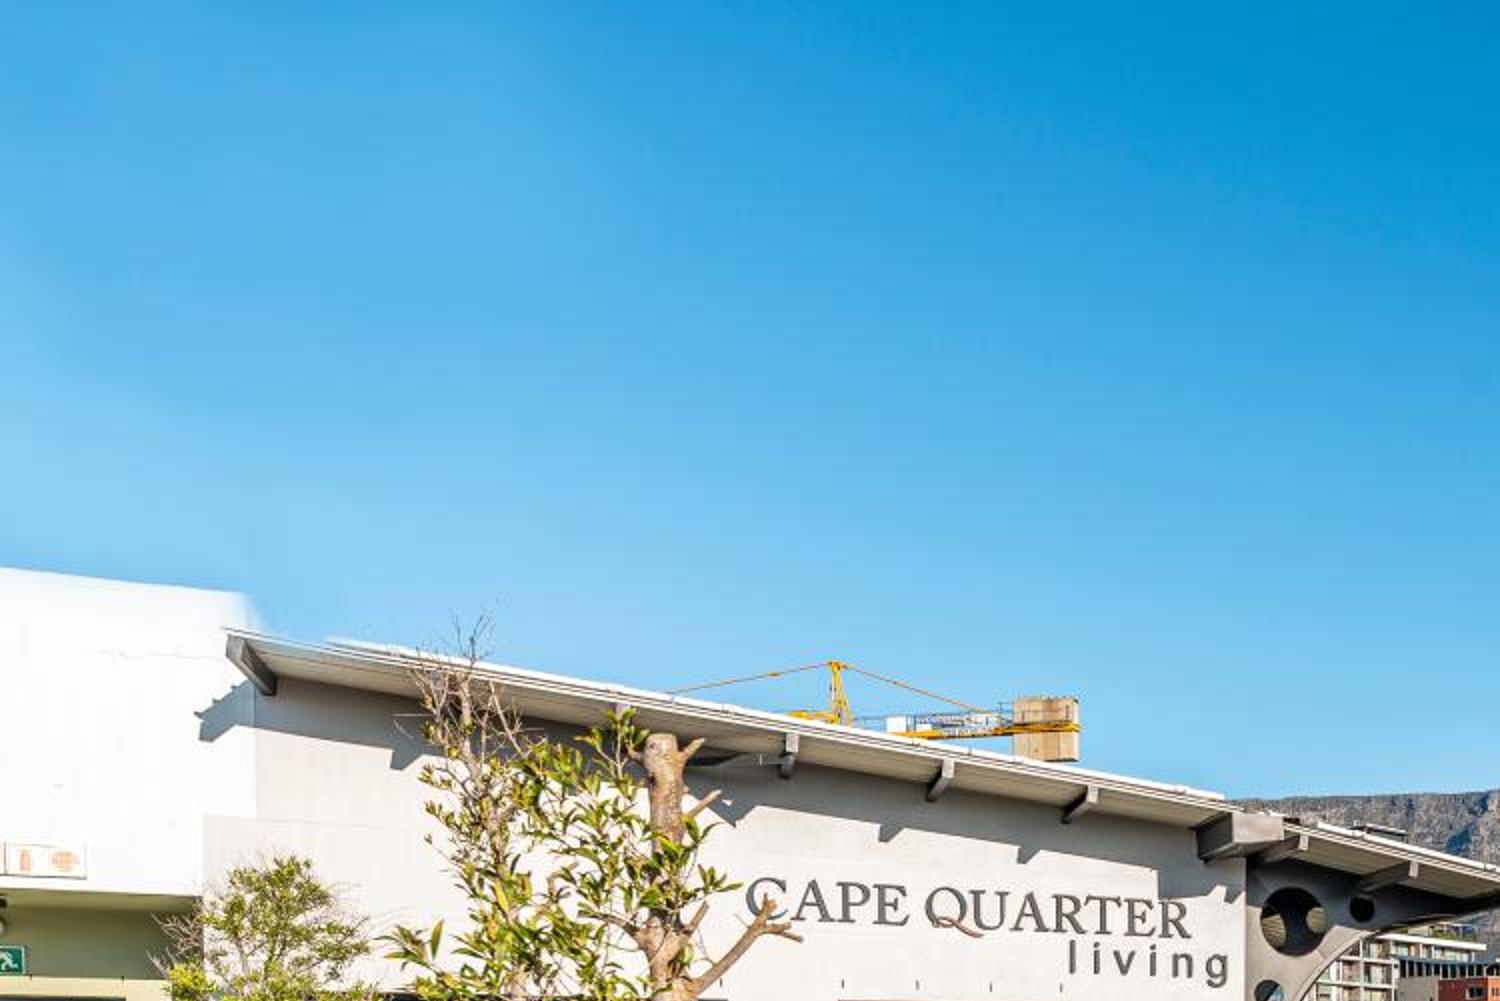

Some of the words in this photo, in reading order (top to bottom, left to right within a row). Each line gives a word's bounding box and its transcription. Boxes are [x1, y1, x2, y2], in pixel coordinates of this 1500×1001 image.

[746, 877, 910, 926] CAPE
[924, 886, 1192, 938] QUARTER
[1069, 939, 1228, 988] living
